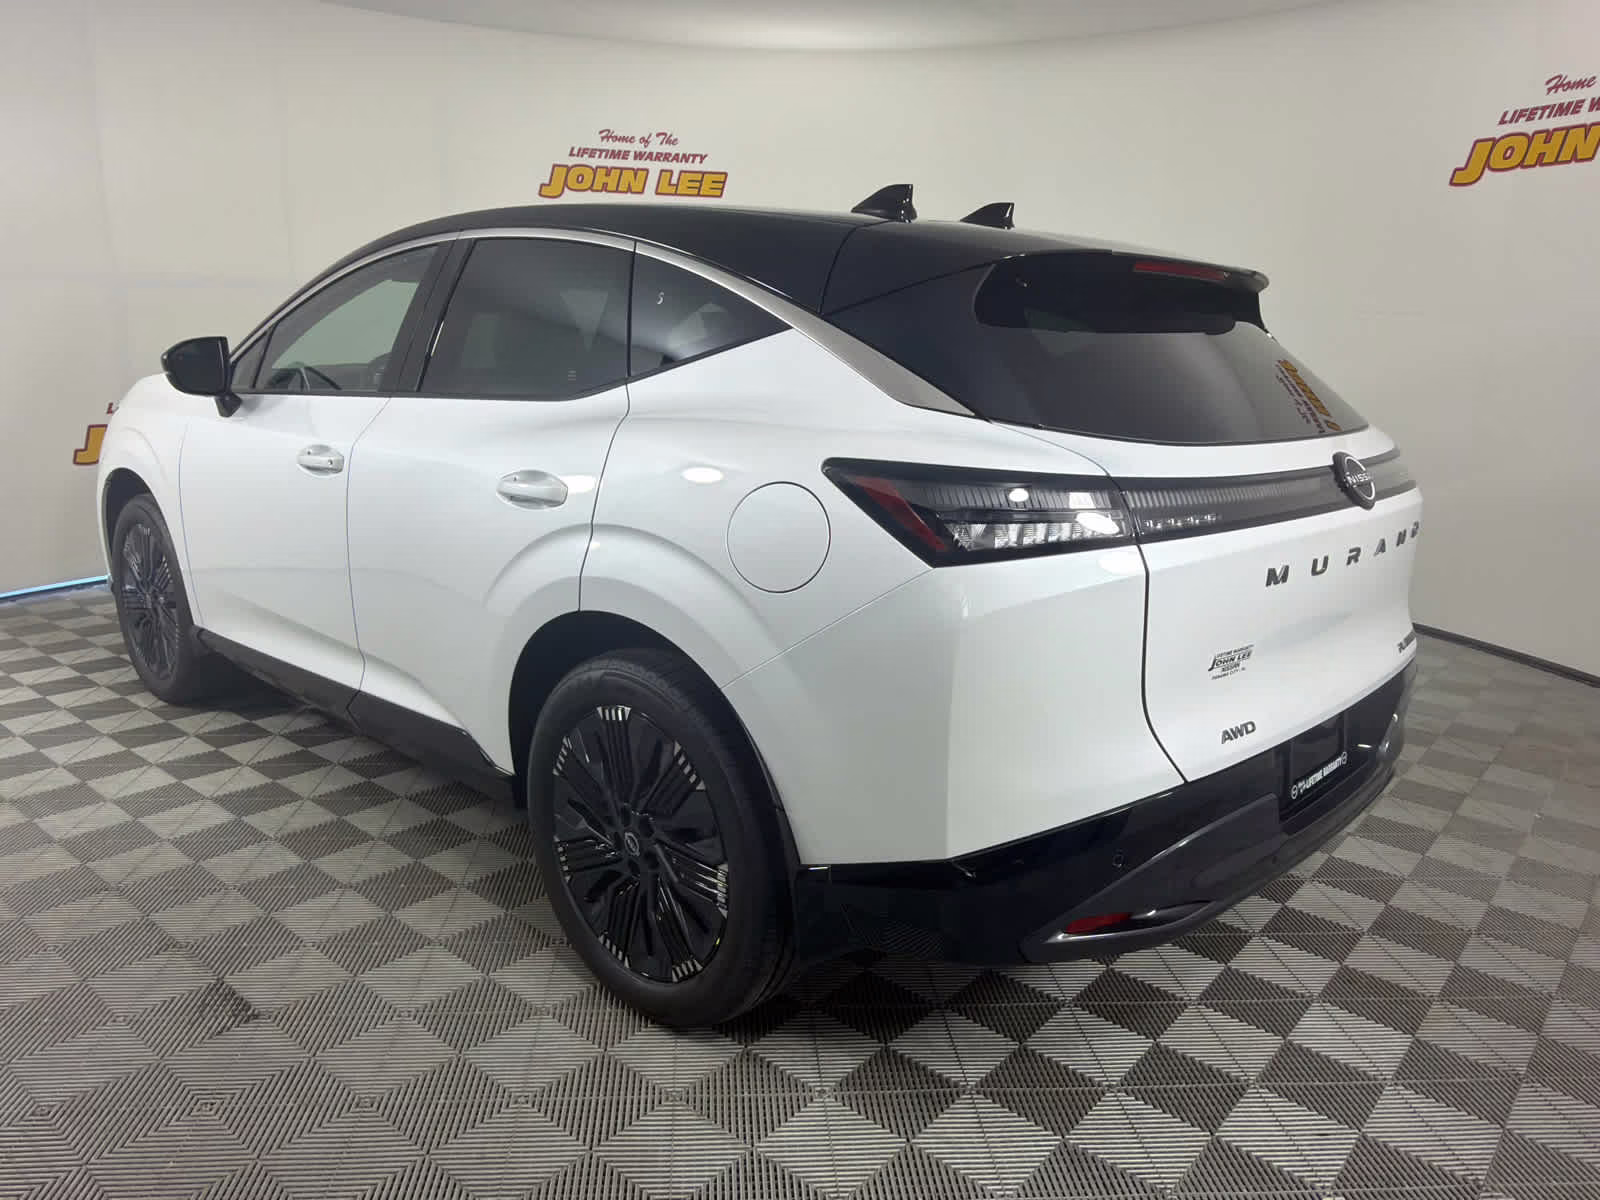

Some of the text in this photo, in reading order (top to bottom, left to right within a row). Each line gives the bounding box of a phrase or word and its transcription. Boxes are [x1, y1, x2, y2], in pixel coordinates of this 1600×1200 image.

[1545, 73, 1597, 96] Home
[1498, 99, 1586, 125] LIFETIME
[598, 128, 679, 147] Home of The
[568, 147, 708, 165] LIFETIME WARRANTY
[1449, 121, 1600, 187] JOHN
[538, 164, 728, 199] JOHN LEE
[1221, 720, 1256, 744] AWD
